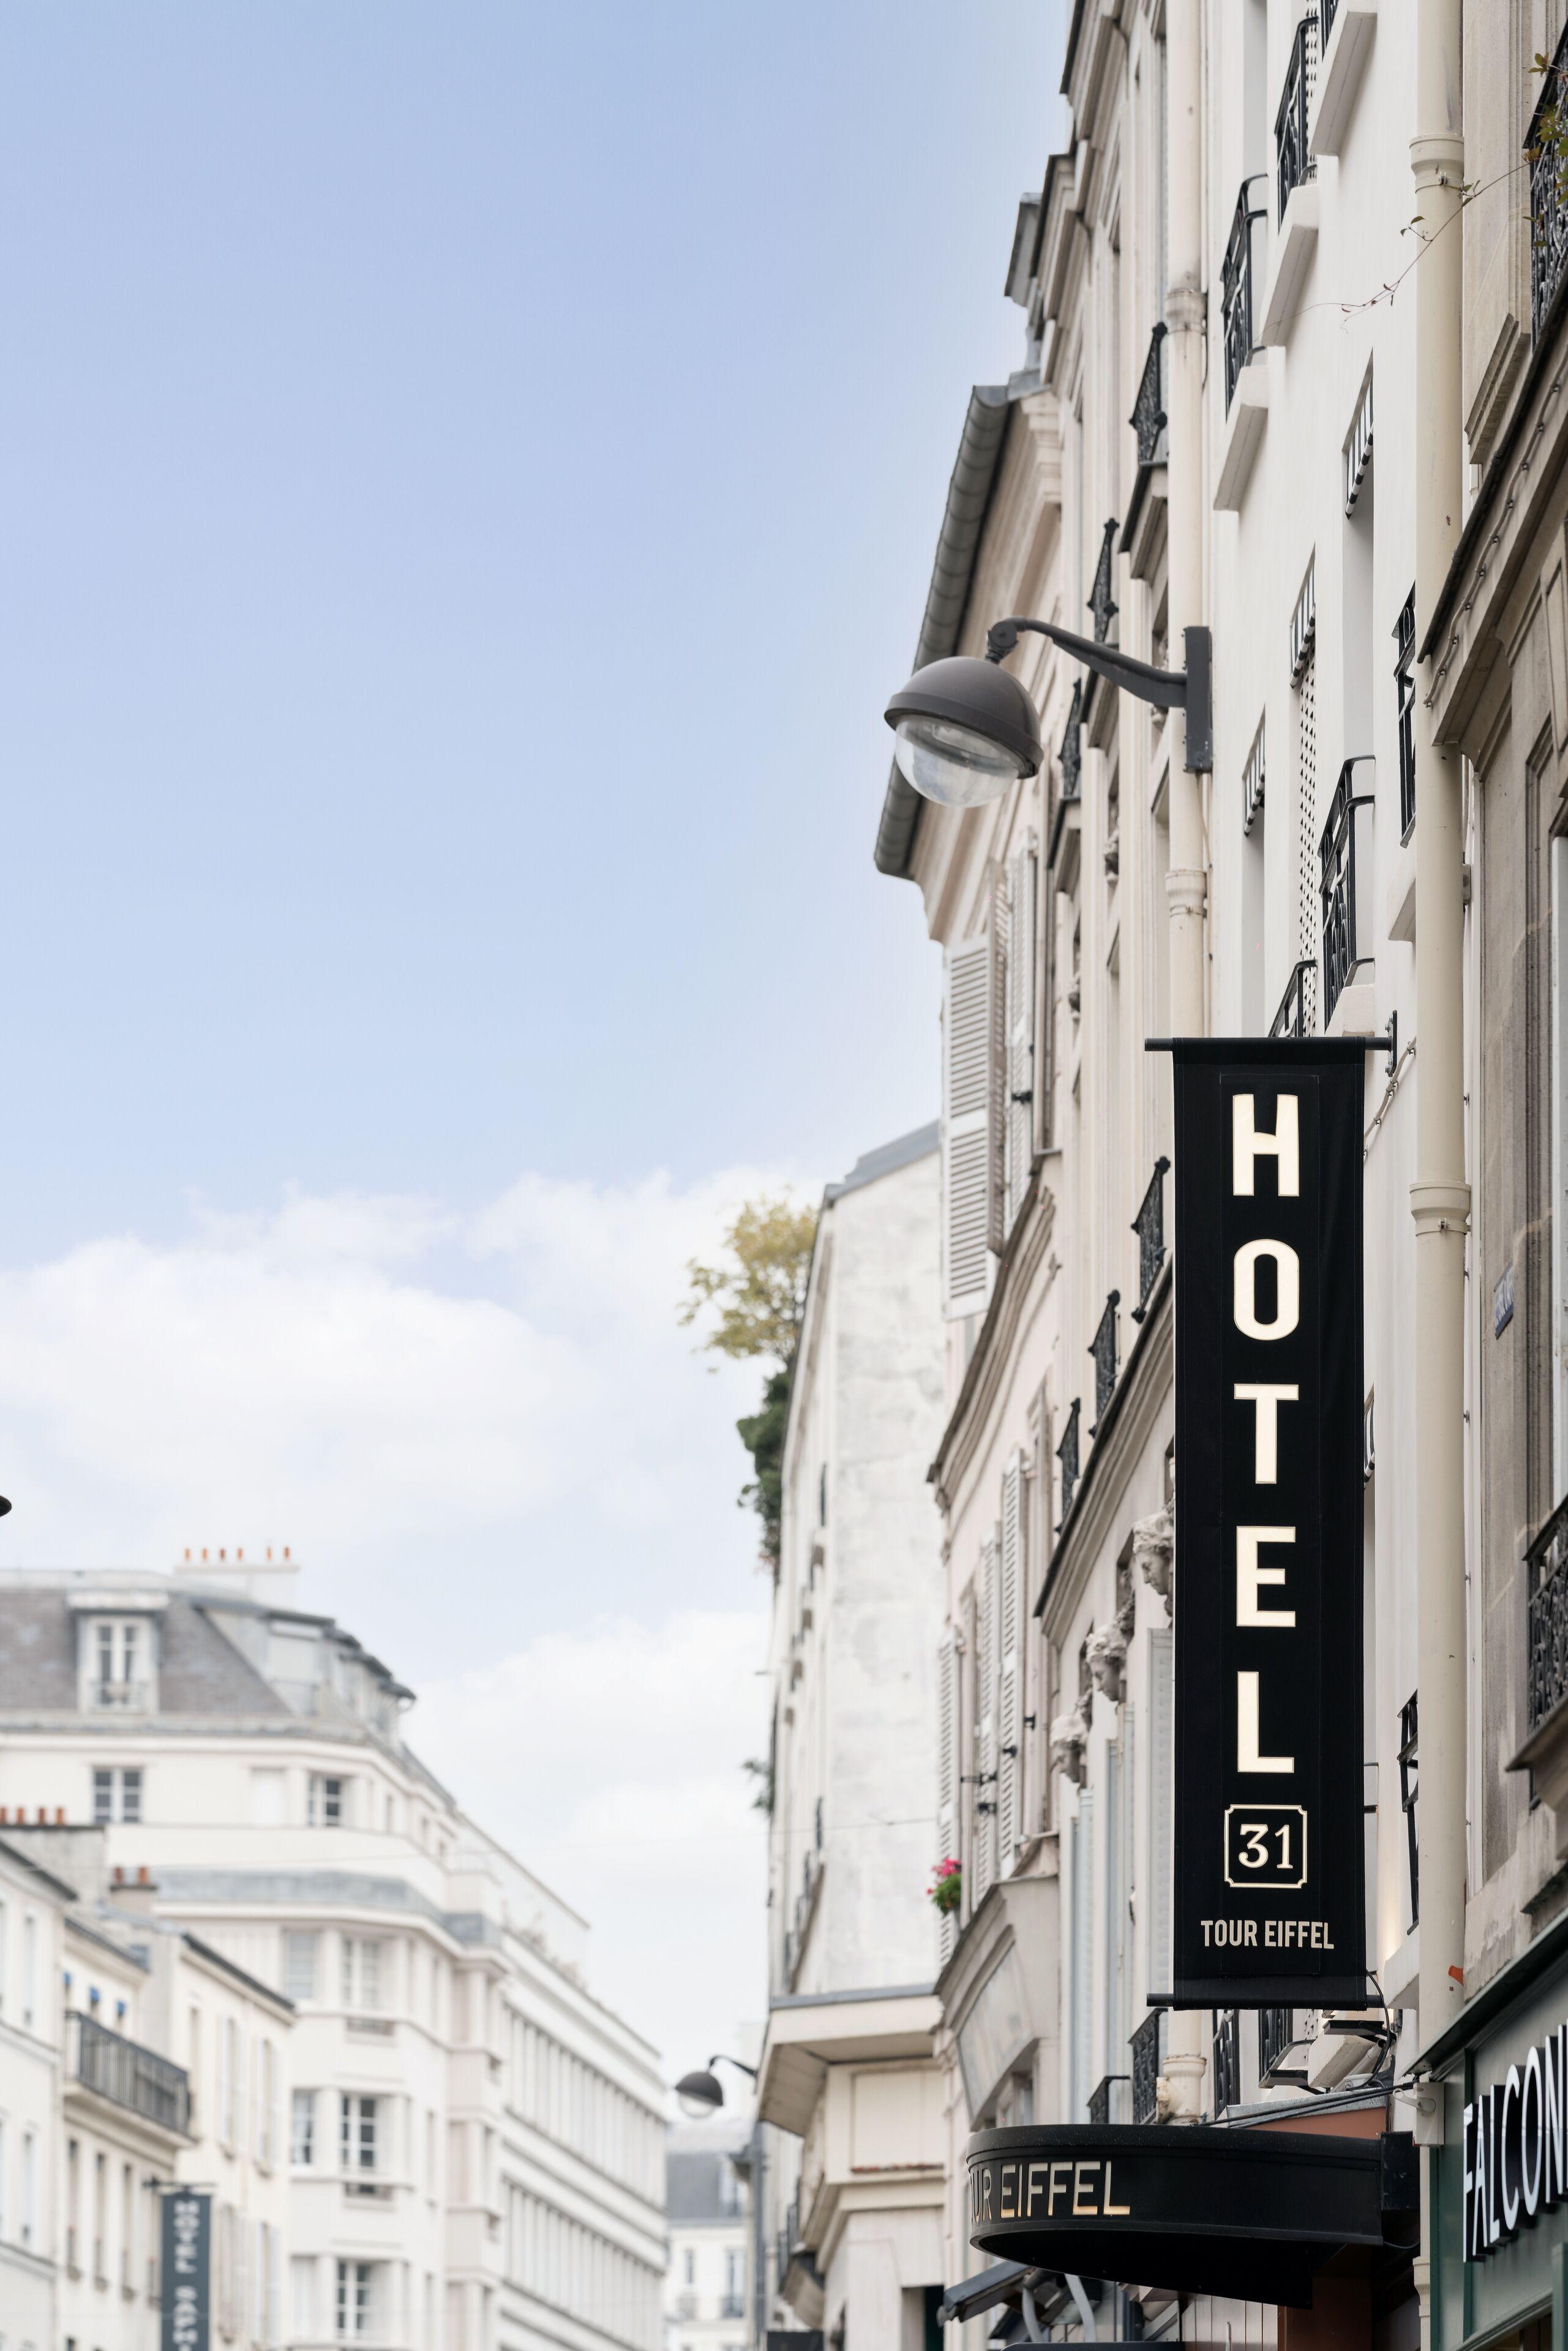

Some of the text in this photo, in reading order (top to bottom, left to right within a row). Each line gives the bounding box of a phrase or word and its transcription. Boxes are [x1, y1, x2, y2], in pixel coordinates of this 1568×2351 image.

[1232, 1093, 1299, 1773] HOTEL
[1239, 1824, 1293, 1869] 31
[1201, 1919, 1334, 1949] TOUR EIFFEL
[1463, 2018, 1568, 2262] FALCON
[970, 2161, 1130, 2224] UR EIFFEL
